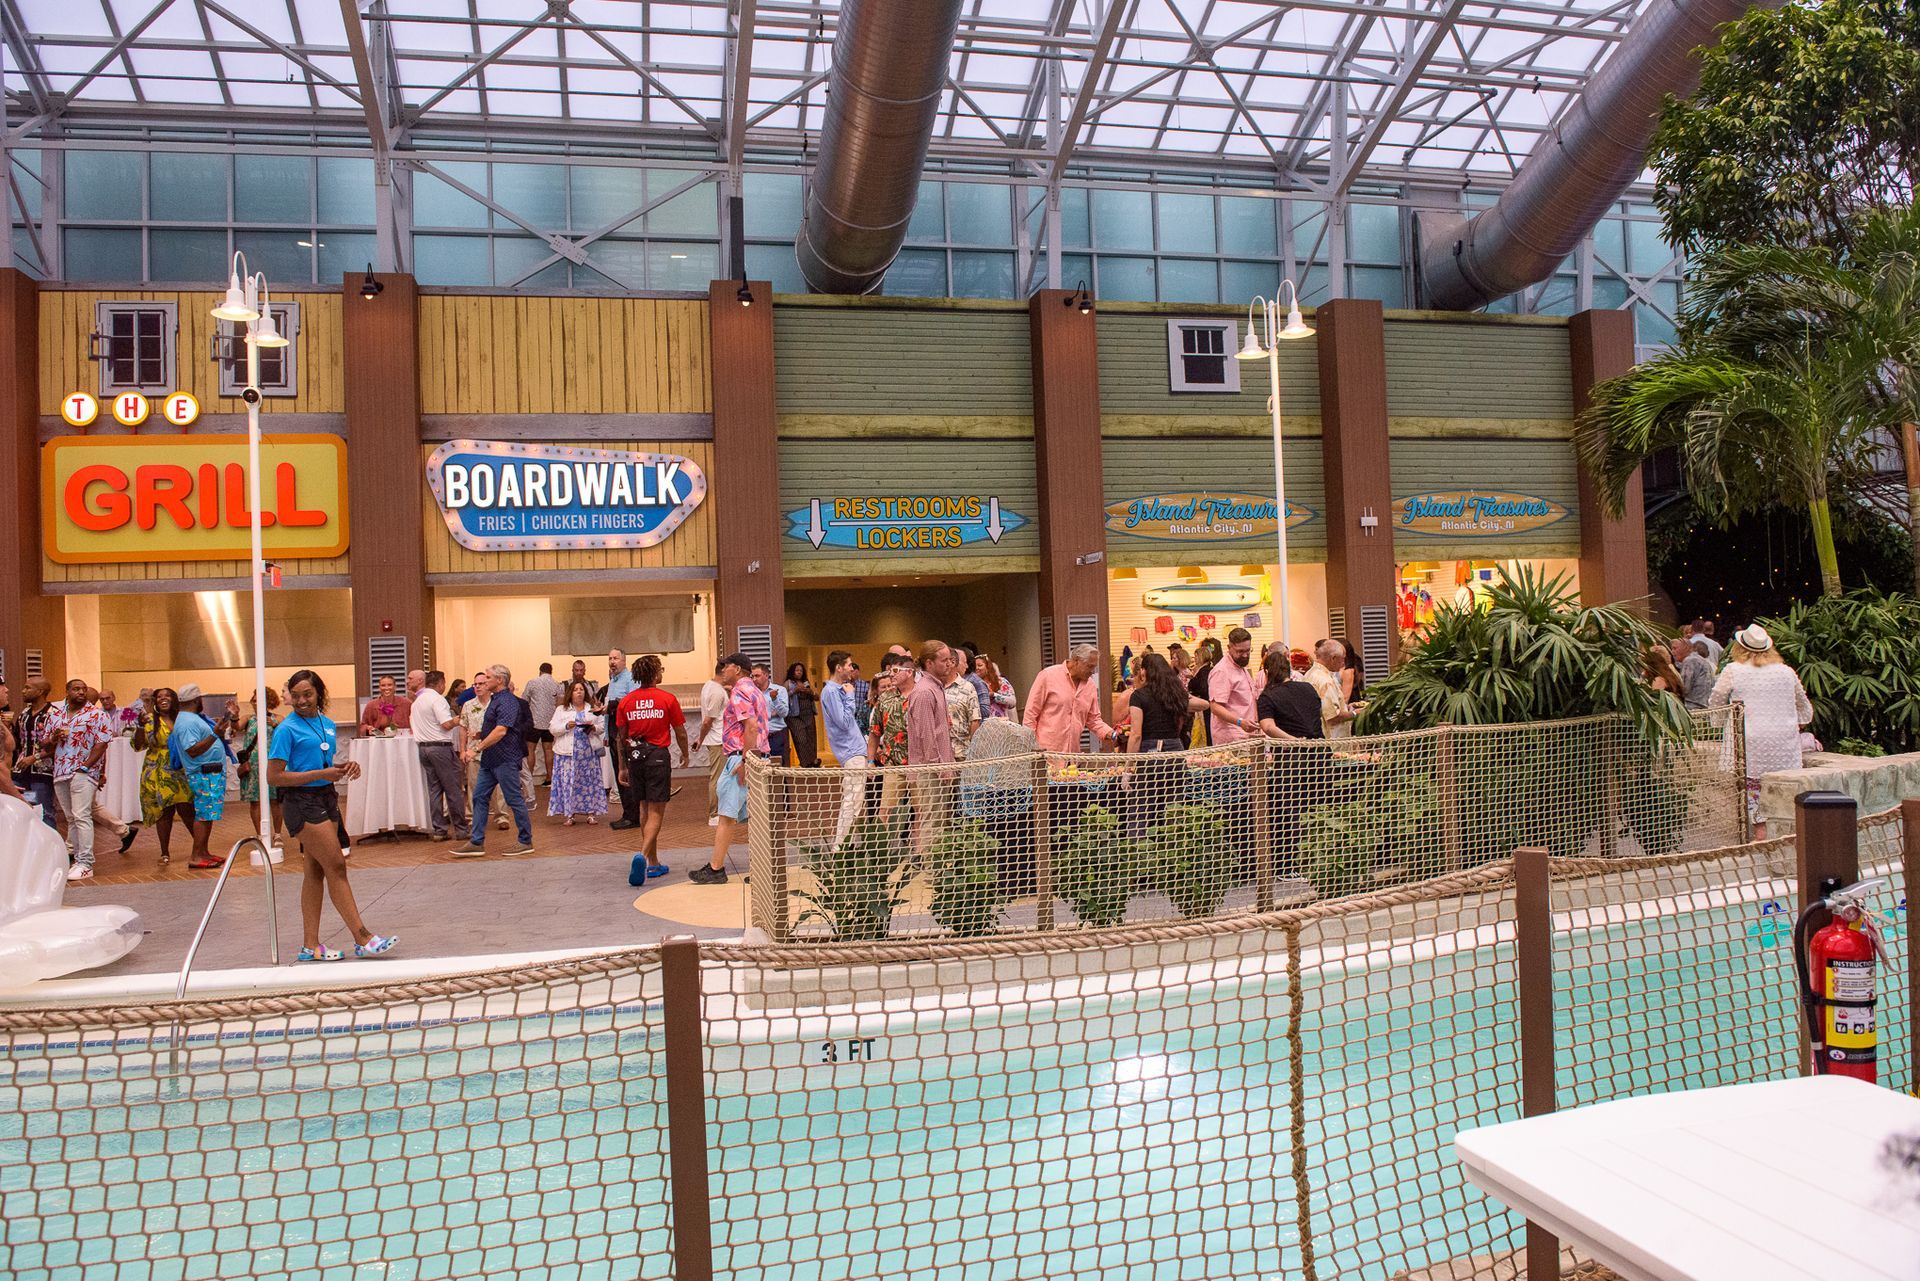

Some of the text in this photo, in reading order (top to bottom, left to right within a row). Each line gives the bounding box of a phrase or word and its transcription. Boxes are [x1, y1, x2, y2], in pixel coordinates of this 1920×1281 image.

[71, 397, 188, 420] THE
[444, 461, 684, 508] BOARDWALK
[64, 462, 328, 531] GRILL
[834, 496, 982, 518] RESTROOMS
[1124, 497, 1197, 528] Island
[1401, 495, 1551, 525] Island Treasures
[479, 513, 645, 531] FRIES CHICKEN FINGERS
[1169, 524, 1211, 534] Atlantic
[1242, 523, 1253, 533] NJ
[1441, 520, 1478, 530] Atlantic
[856, 527, 962, 549] LOCKERS
[626, 709, 664, 720] LIFEGUARD
[635, 699, 654, 710] LEAD
[821, 1038, 876, 1063] 3 FT
